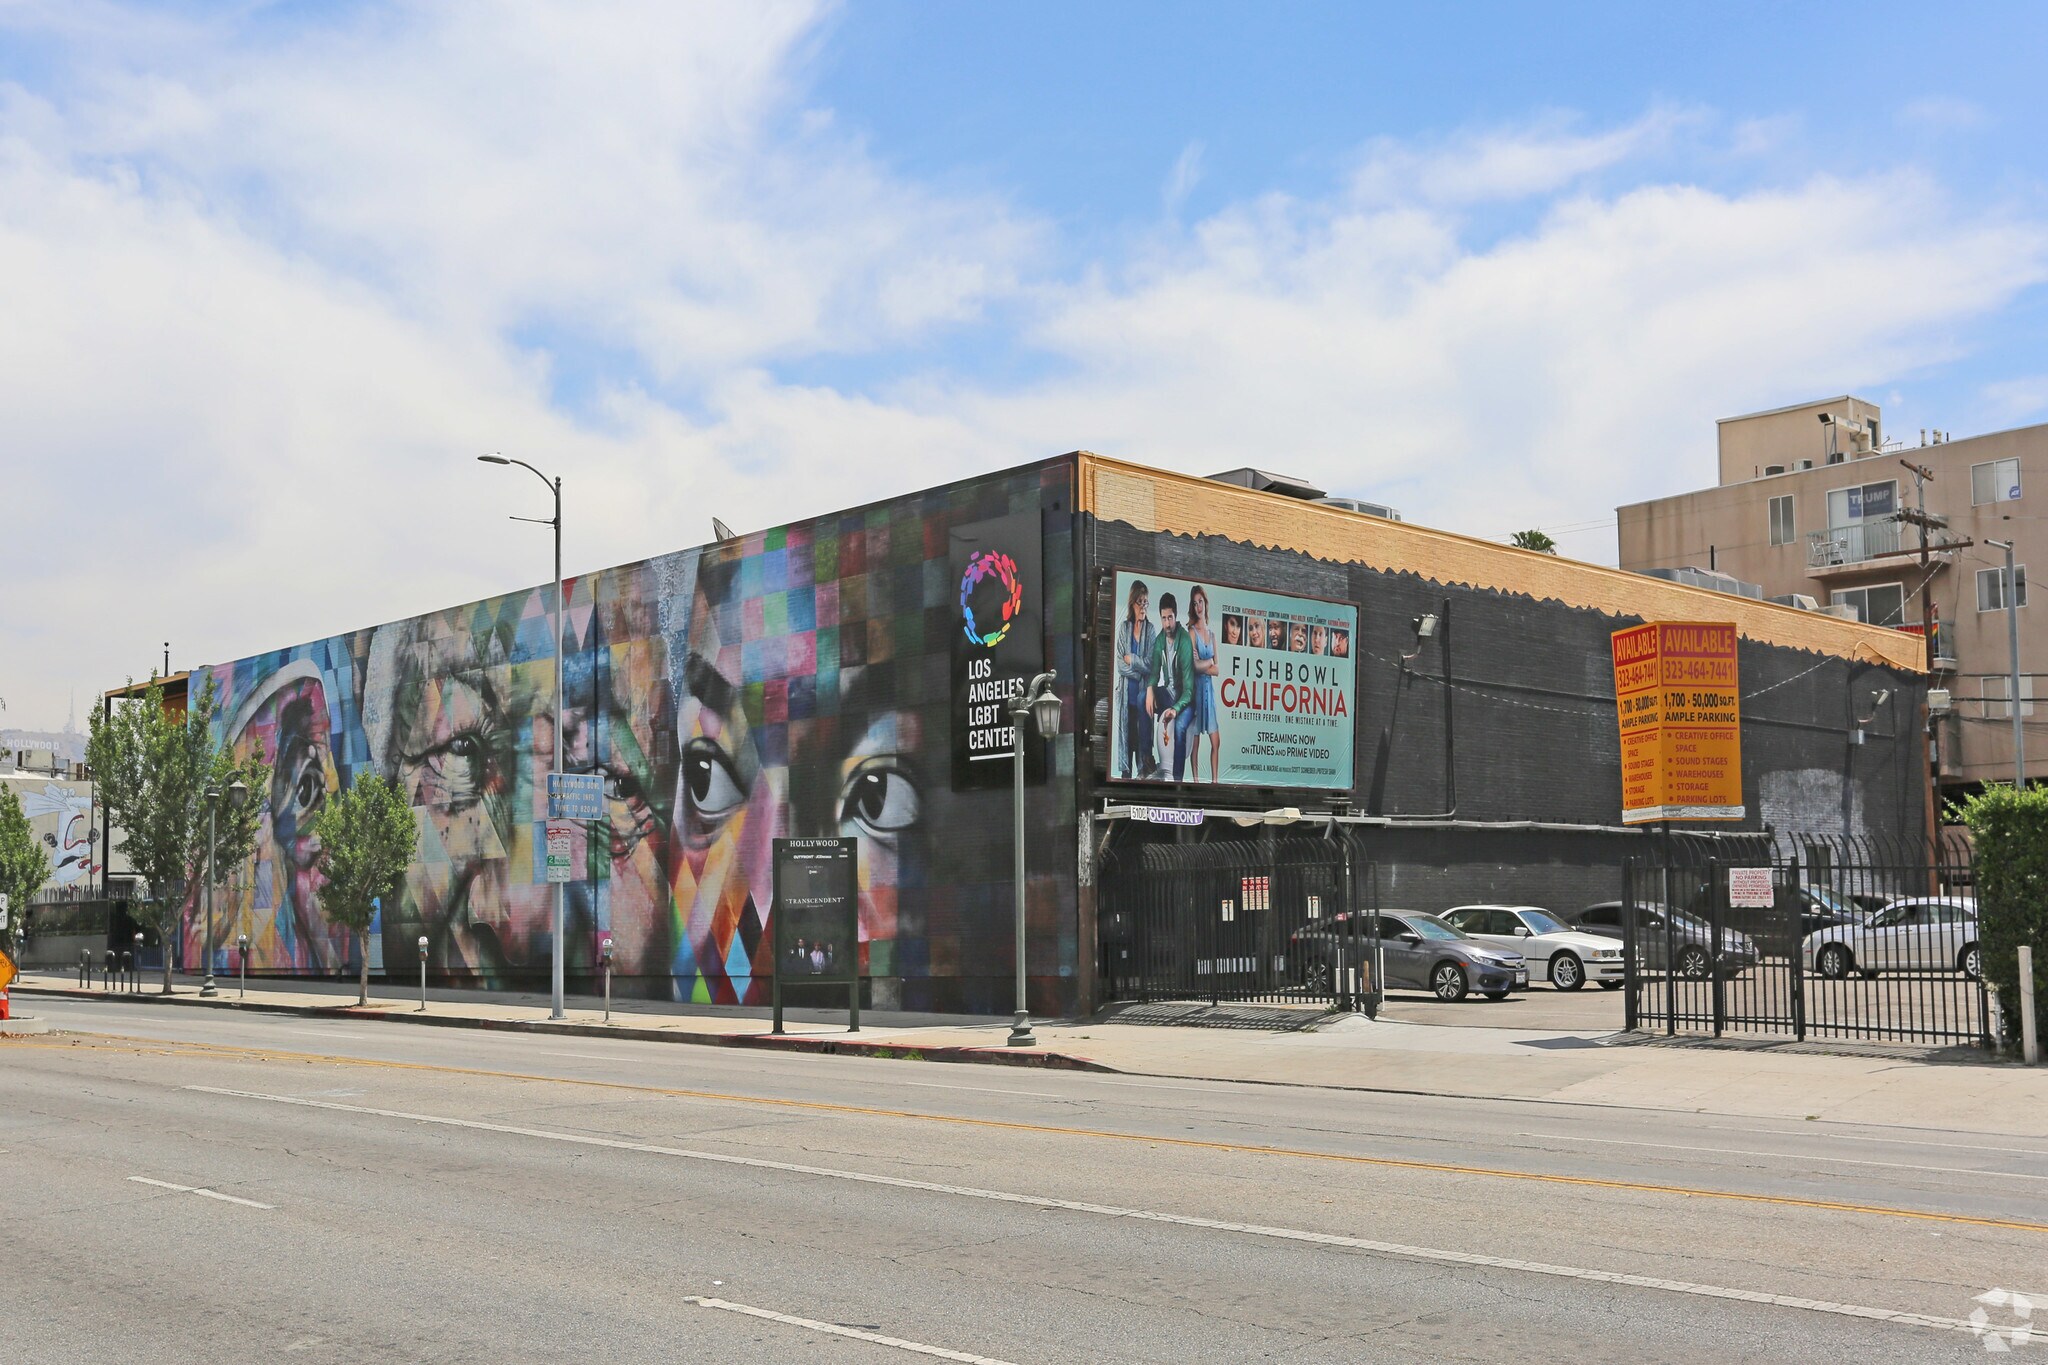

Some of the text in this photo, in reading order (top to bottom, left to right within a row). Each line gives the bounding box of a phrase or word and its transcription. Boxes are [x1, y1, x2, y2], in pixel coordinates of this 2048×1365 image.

[1616, 630, 1656, 662] AVAILABLE
[1665, 629, 1732, 653] AVAILABLE
[968, 658, 992, 680] LOS
[1232, 656, 1338, 686] FISHBOWL
[1618, 662, 1657, 688] 323-464-7441
[1666, 660, 1732, 680] 323-464-7441
[968, 678, 1024, 703] ANGELES
[1221, 678, 1347, 717] CALIFORNIA
[1664, 692, 1686, 710] 1,700
[1692, 693, 1718, 710] 50,000
[969, 704, 1000, 726] LGBT
[1232, 711, 1238, 719] BE
[1240, 712, 1242, 720] A
[1244, 712, 1260, 721] BETTER
[1286, 716, 1294, 724] ONE
[1296, 716, 1314, 725] MISTAKE
[1316, 718, 1320, 726] AT
[1322, 718, 1326, 726] A
[1622, 712, 1658, 728] AMPLE PARKING
[1664, 712, 1736, 722] AMPLE PARKING
[969, 726, 1016, 750] CENTER
[1258, 732, 1316, 745] STREAMING NOW
[1628, 733, 1658, 746] CREATIVE OFFICE
[1675, 732, 1734, 740] CREATIVE OFFICE
[7, 739, 60, 750] HOLLYWOOD
[1676, 744, 1696, 752] SPACE
[1242, 746, 1250, 754] ON
[1250, 744, 1274, 756] iTUNES
[1286, 747, 1308, 758] PRIME
[1309, 749, 1330, 759] VIDEO
[1628, 748, 1638, 758] SPACE
[1628, 759, 1654, 770] SOUND STAGES
[1676, 757, 1728, 766] SOUND STAGES
[1628, 772, 1652, 782] WAREHOUSES
[1676, 770, 1724, 778] WAREHOUSES
[552, 780, 584, 789] HOLLYWOOD
[1629, 785, 1644, 795] STORAGE
[1676, 782, 1709, 790] STORAGE
[1676, 795, 1726, 804] PARKING LOTS
[1150, 809, 1200, 824] OUTFRONT
[548, 856, 554, 864] 2
